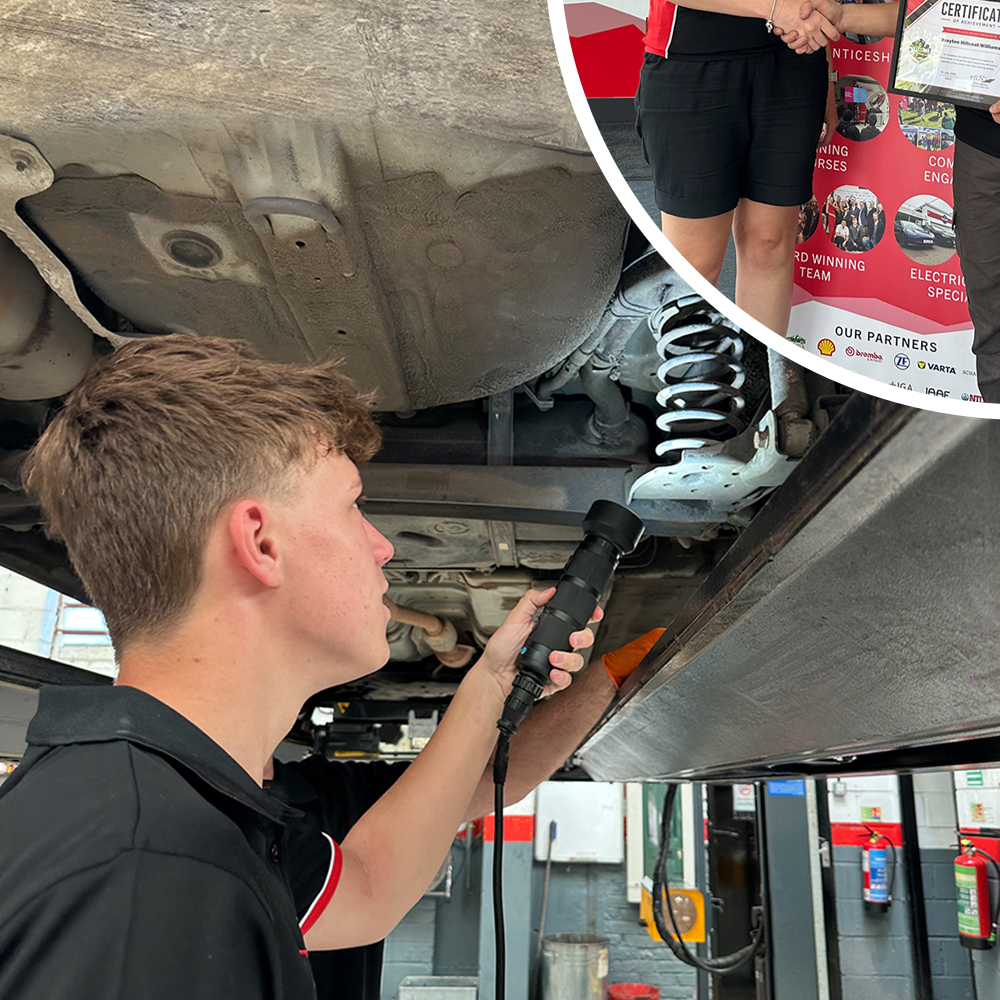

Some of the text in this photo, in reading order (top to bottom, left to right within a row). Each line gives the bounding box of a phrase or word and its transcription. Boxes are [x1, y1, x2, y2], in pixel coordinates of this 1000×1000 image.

[961, 20, 996, 28] ACHIEVEMENT
[812, 254, 866, 272] WINNING
[800, 266, 831, 282] TEAM
[835, 326, 938, 353] OUR PARTNERS
[856, 350, 883, 360] brembo
[928, 363, 956, 375] VARTA
